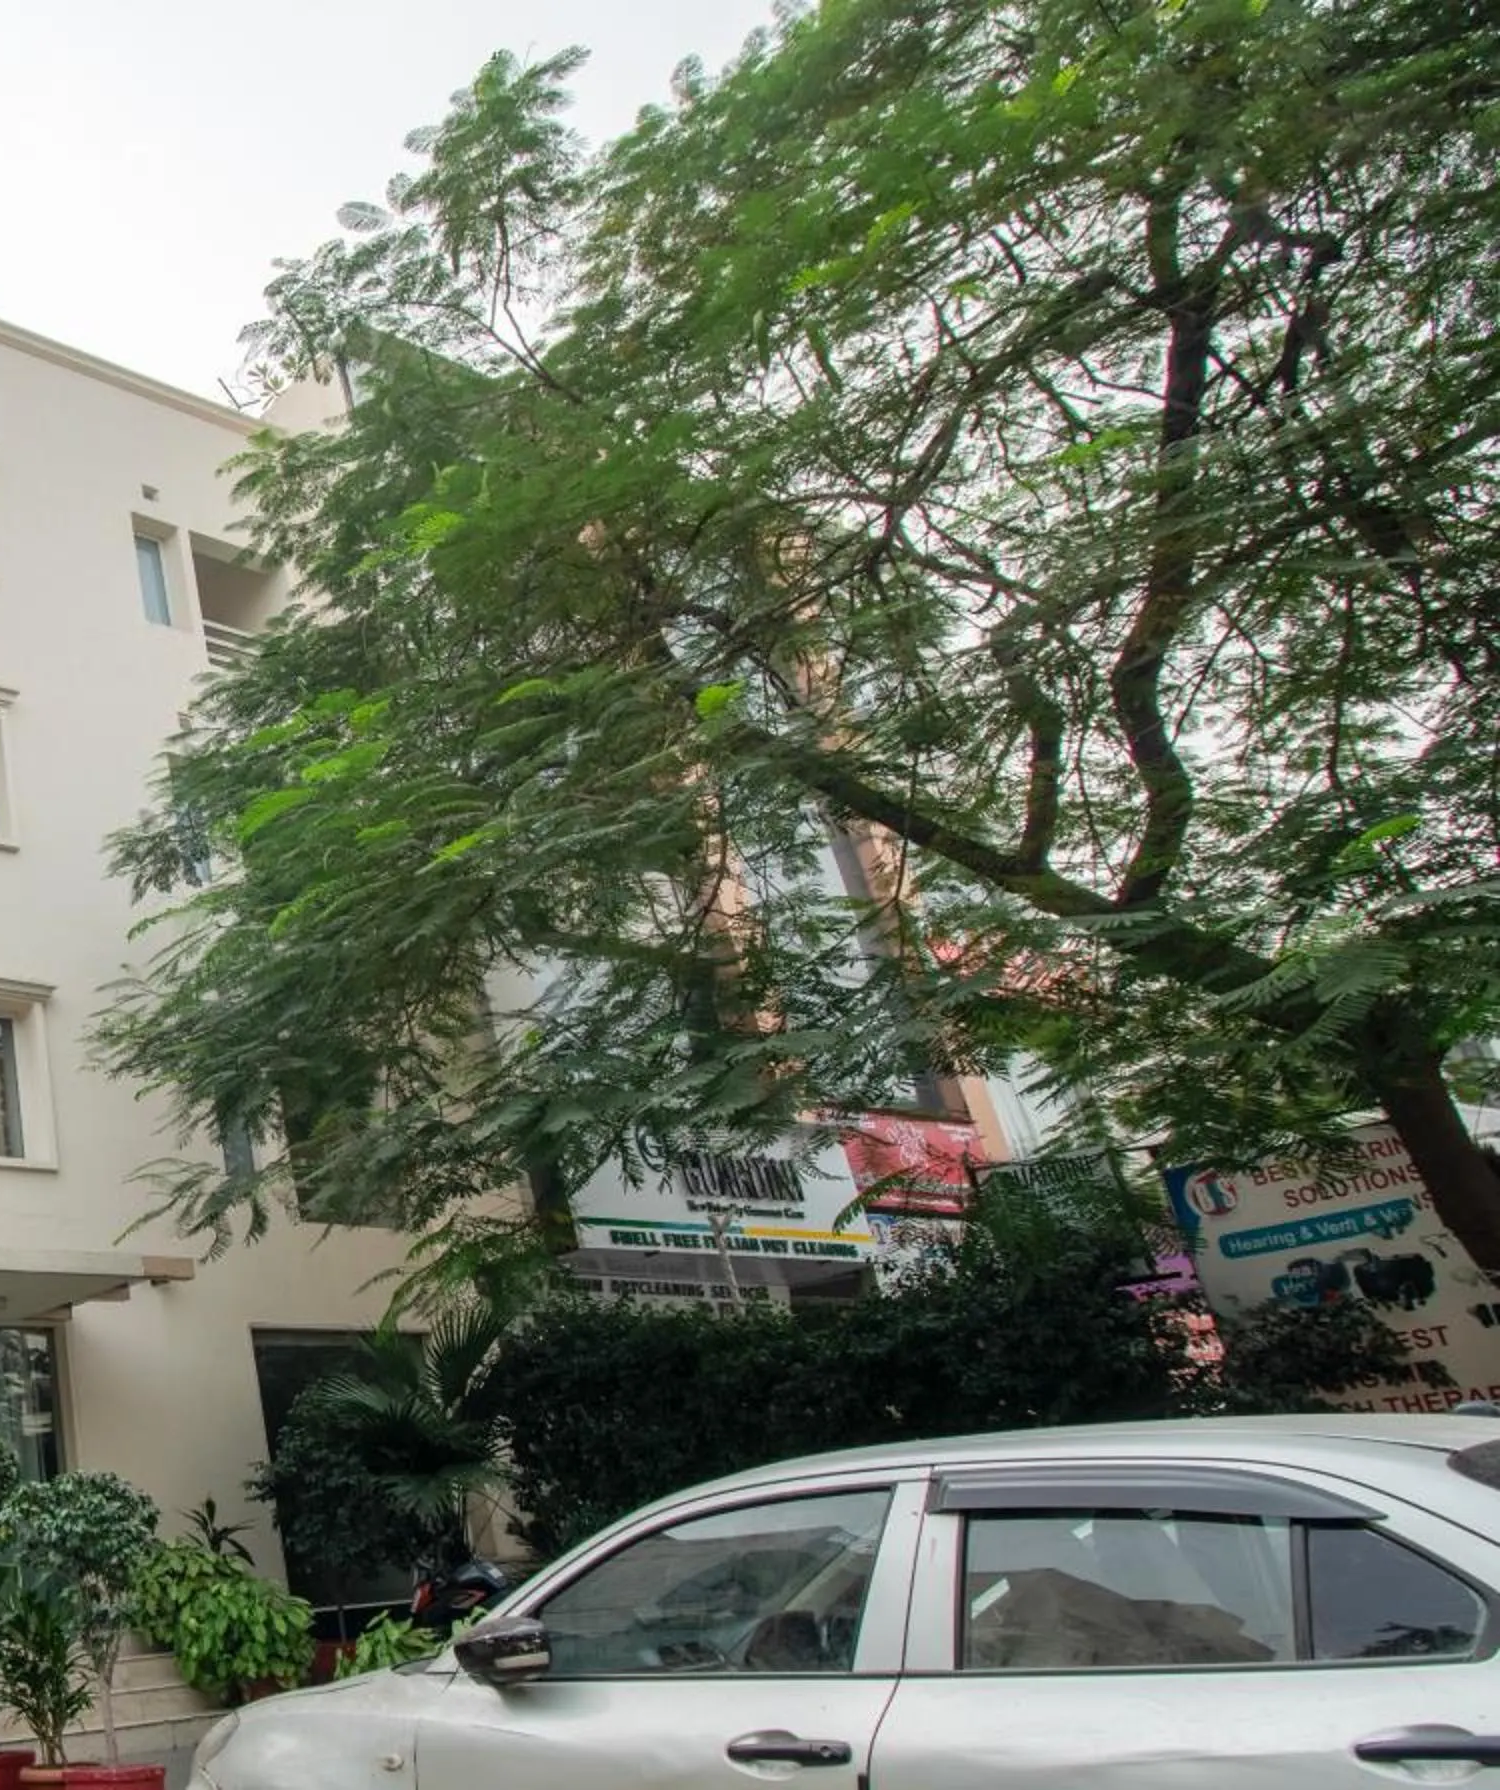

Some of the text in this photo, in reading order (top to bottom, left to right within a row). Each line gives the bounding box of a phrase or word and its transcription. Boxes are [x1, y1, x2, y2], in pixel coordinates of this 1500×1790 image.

[1283, 1163, 1423, 1208] SOLUTIONS
[610, 1230, 660, 1246] SMELL
[662, 1232, 701, 1248] FREE
[703, 1235, 760, 1252] ITLIAN
[1228, 1231, 1297, 1253] Hearing
[1301, 1226, 1313, 1239] &
[1394, 1325, 1448, 1351] EST
